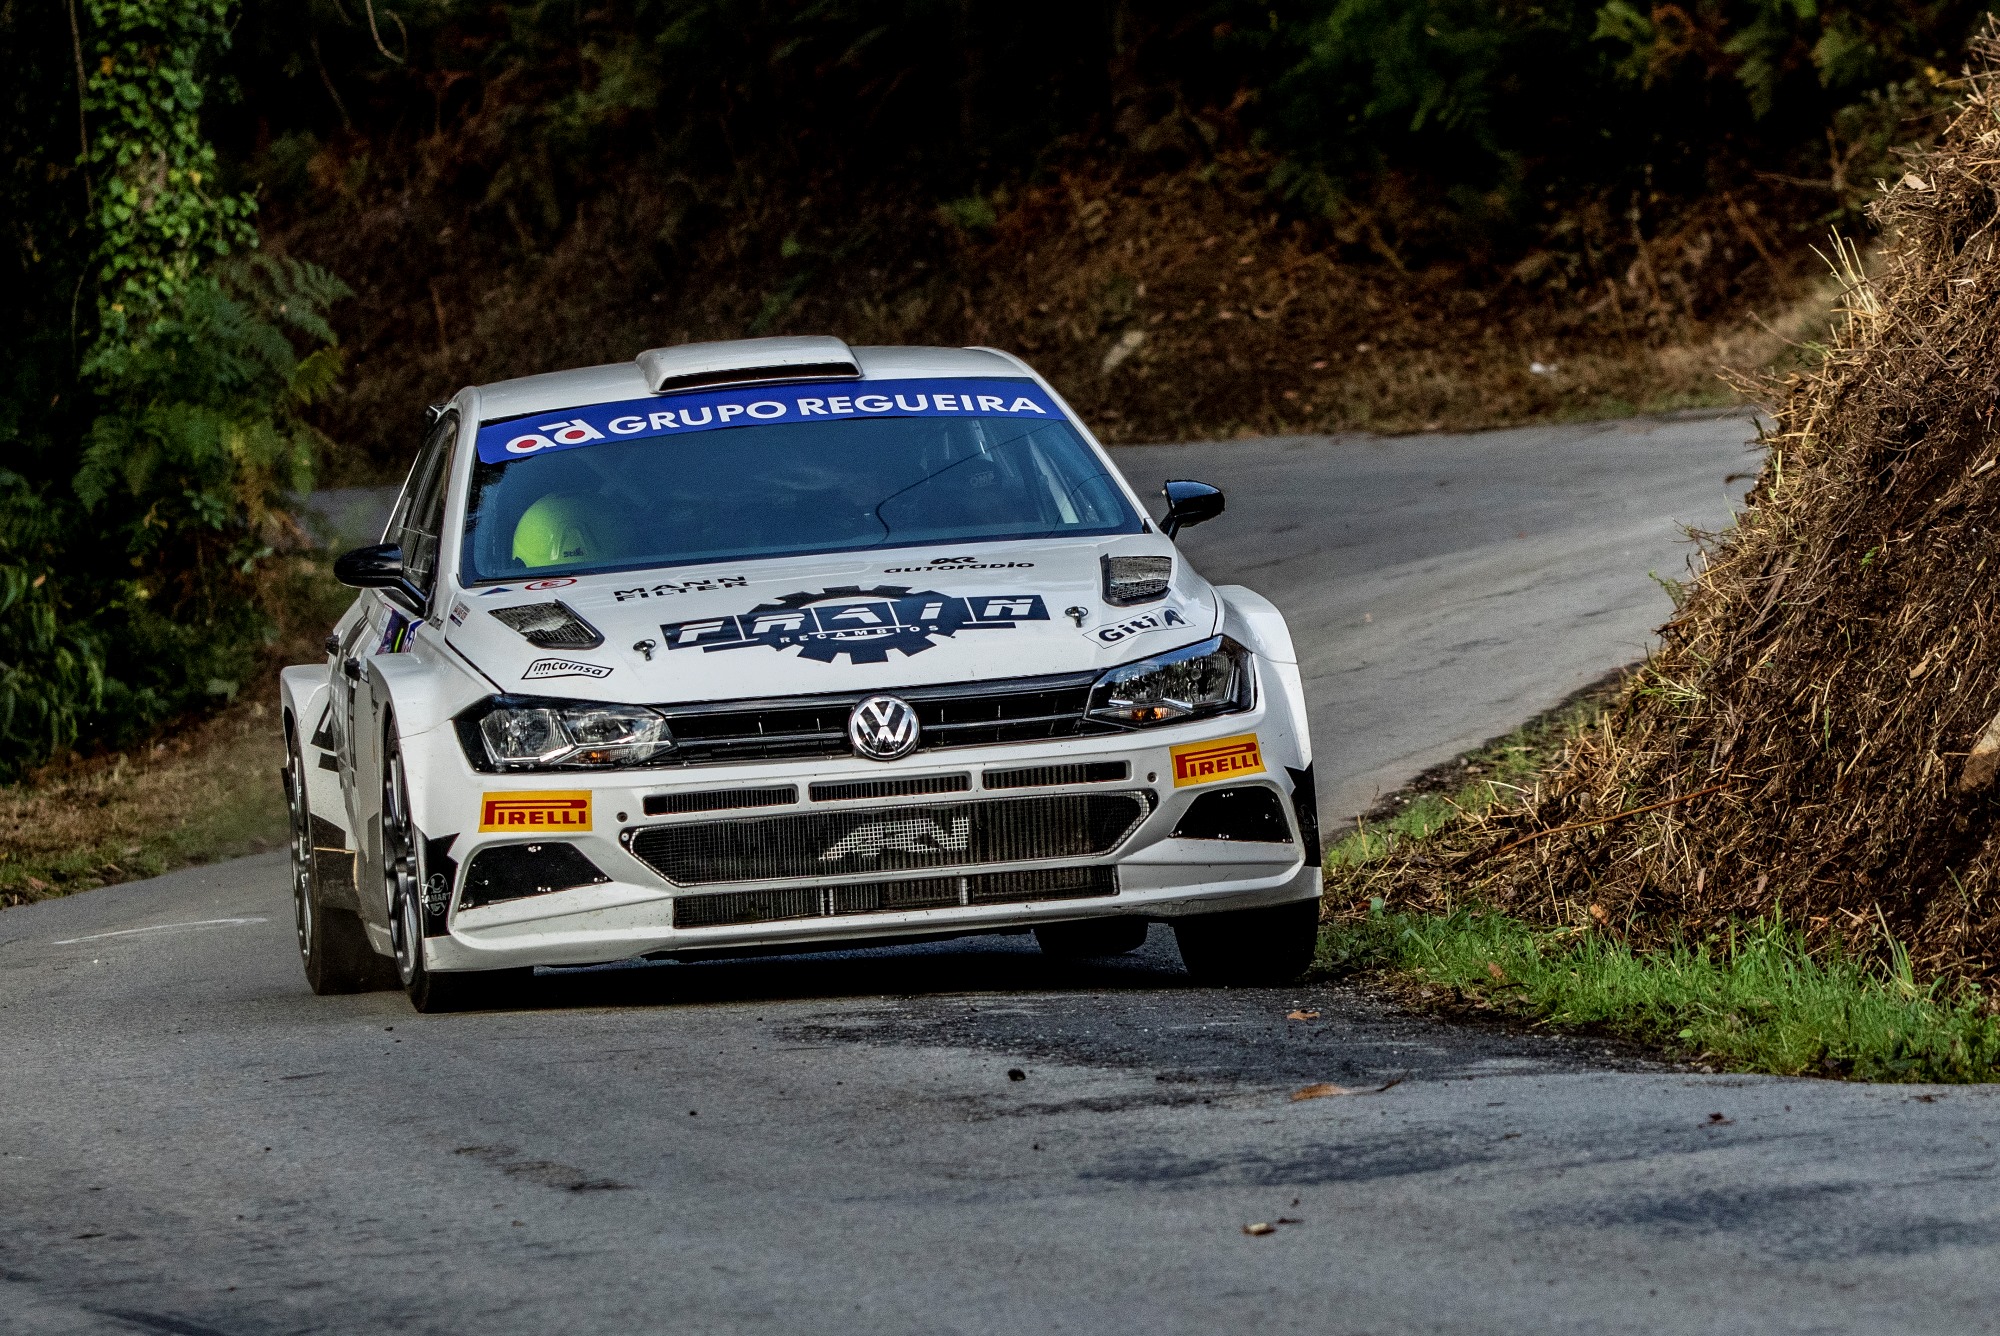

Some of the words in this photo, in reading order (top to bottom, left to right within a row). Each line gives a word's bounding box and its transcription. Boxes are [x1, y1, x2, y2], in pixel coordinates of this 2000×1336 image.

[608, 401, 787, 434] GRUPO
[797, 394, 1047, 415] REGUEIRA
[613, 576, 746, 596] MANN
[616, 582, 749, 602] FILTER
[678, 598, 1033, 644] FRAIN
[1098, 615, 1158, 642] Giti
[779, 625, 939, 644] RECAMBIOS
[533, 661, 604, 676] imcoinsa
[1175, 742, 1260, 780] PIRELLI
[484, 799, 588, 825] PIRELLI
